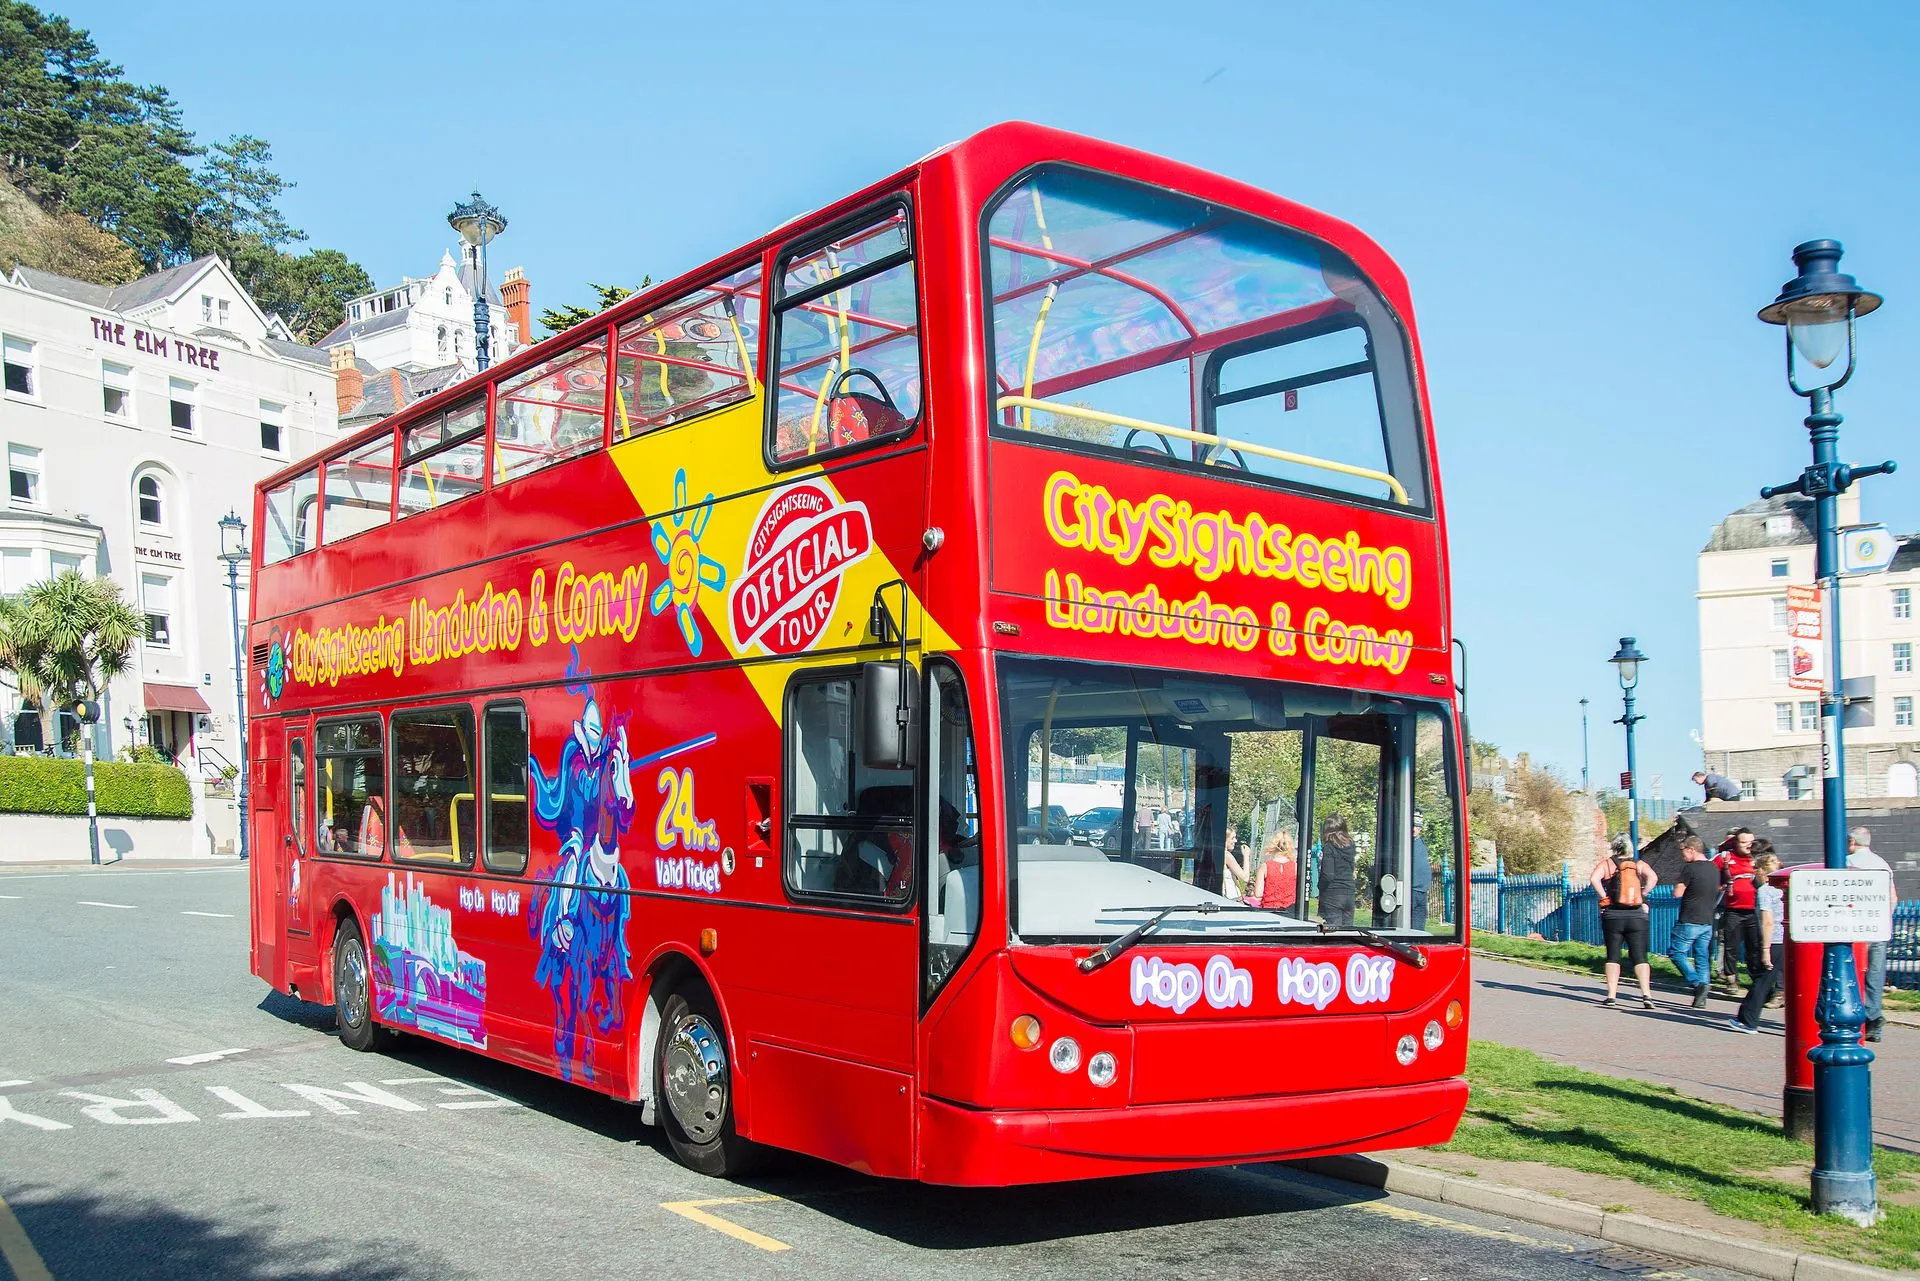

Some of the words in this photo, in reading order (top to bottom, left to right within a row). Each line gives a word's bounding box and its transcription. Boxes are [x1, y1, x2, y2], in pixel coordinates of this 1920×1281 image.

[90, 316, 126, 347] THE
[133, 329, 168, 358] ELM
[174, 340, 220, 372] TREE
[134, 546, 147, 556] THE
[164, 550, 182, 561] TREE
[754, 493, 824, 558] CITYSIGHTSEEING
[1043, 470, 1412, 610] CitySightseeing
[742, 517, 858, 628] OFFICIAL
[293, 614, 405, 688] CitySightseeing
[410, 581, 523, 666] Llandudno
[528, 567, 548, 647] &
[554, 560, 649, 644] Conwy
[779, 590, 831, 647] TOUR
[1045, 568, 1260, 652] Llandudno
[1268, 601, 1296, 657] &
[1304, 606, 1413, 676] Conwy
[460, 886, 473, 912] Hop
[474, 886, 485, 912] On
[492, 889, 506, 917] Hop
[507, 889, 520, 916] Off
[655, 856, 684, 888] Valid
[684, 857, 721, 894] Ticket
[1825, 894, 1837, 902] AR
[1843, 879, 1874, 887] CADW
[1800, 910, 1829, 918] DOGS
[1867, 910, 1880, 918] BE
[1804, 925, 1828, 933] KEPT
[1853, 925, 1879, 933] LEAD
[1130, 955, 1202, 1014] Hop
[1204, 954, 1253, 1008] On
[1277, 957, 1341, 1011] Hop
[1345, 953, 1396, 1005] Off
